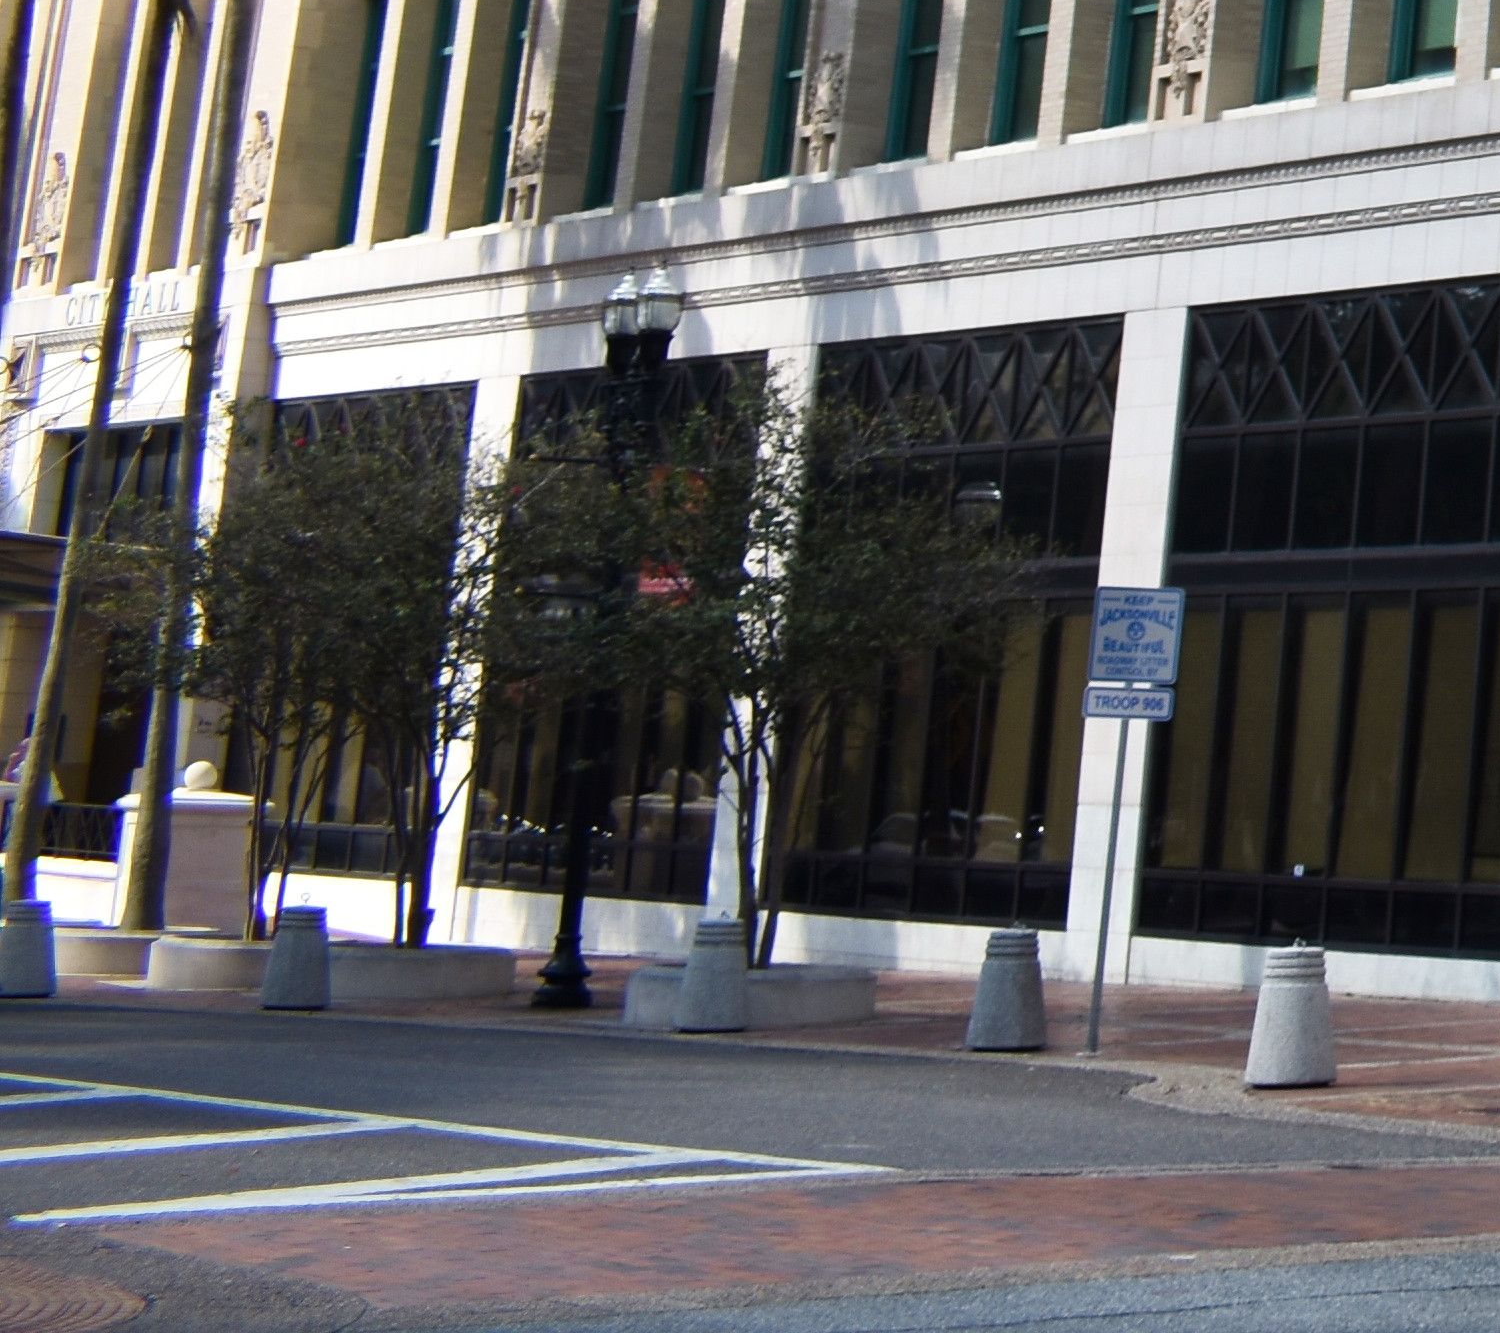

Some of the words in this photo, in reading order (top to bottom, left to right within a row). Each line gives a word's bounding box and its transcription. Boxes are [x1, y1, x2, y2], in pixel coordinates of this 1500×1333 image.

[1123, 595, 1154, 606] KEEP
[1099, 607, 1176, 631] JACKSONVILLE
[1103, 636, 1165, 654] BEAUTIFUL
[1094, 694, 1140, 710] TROOP
